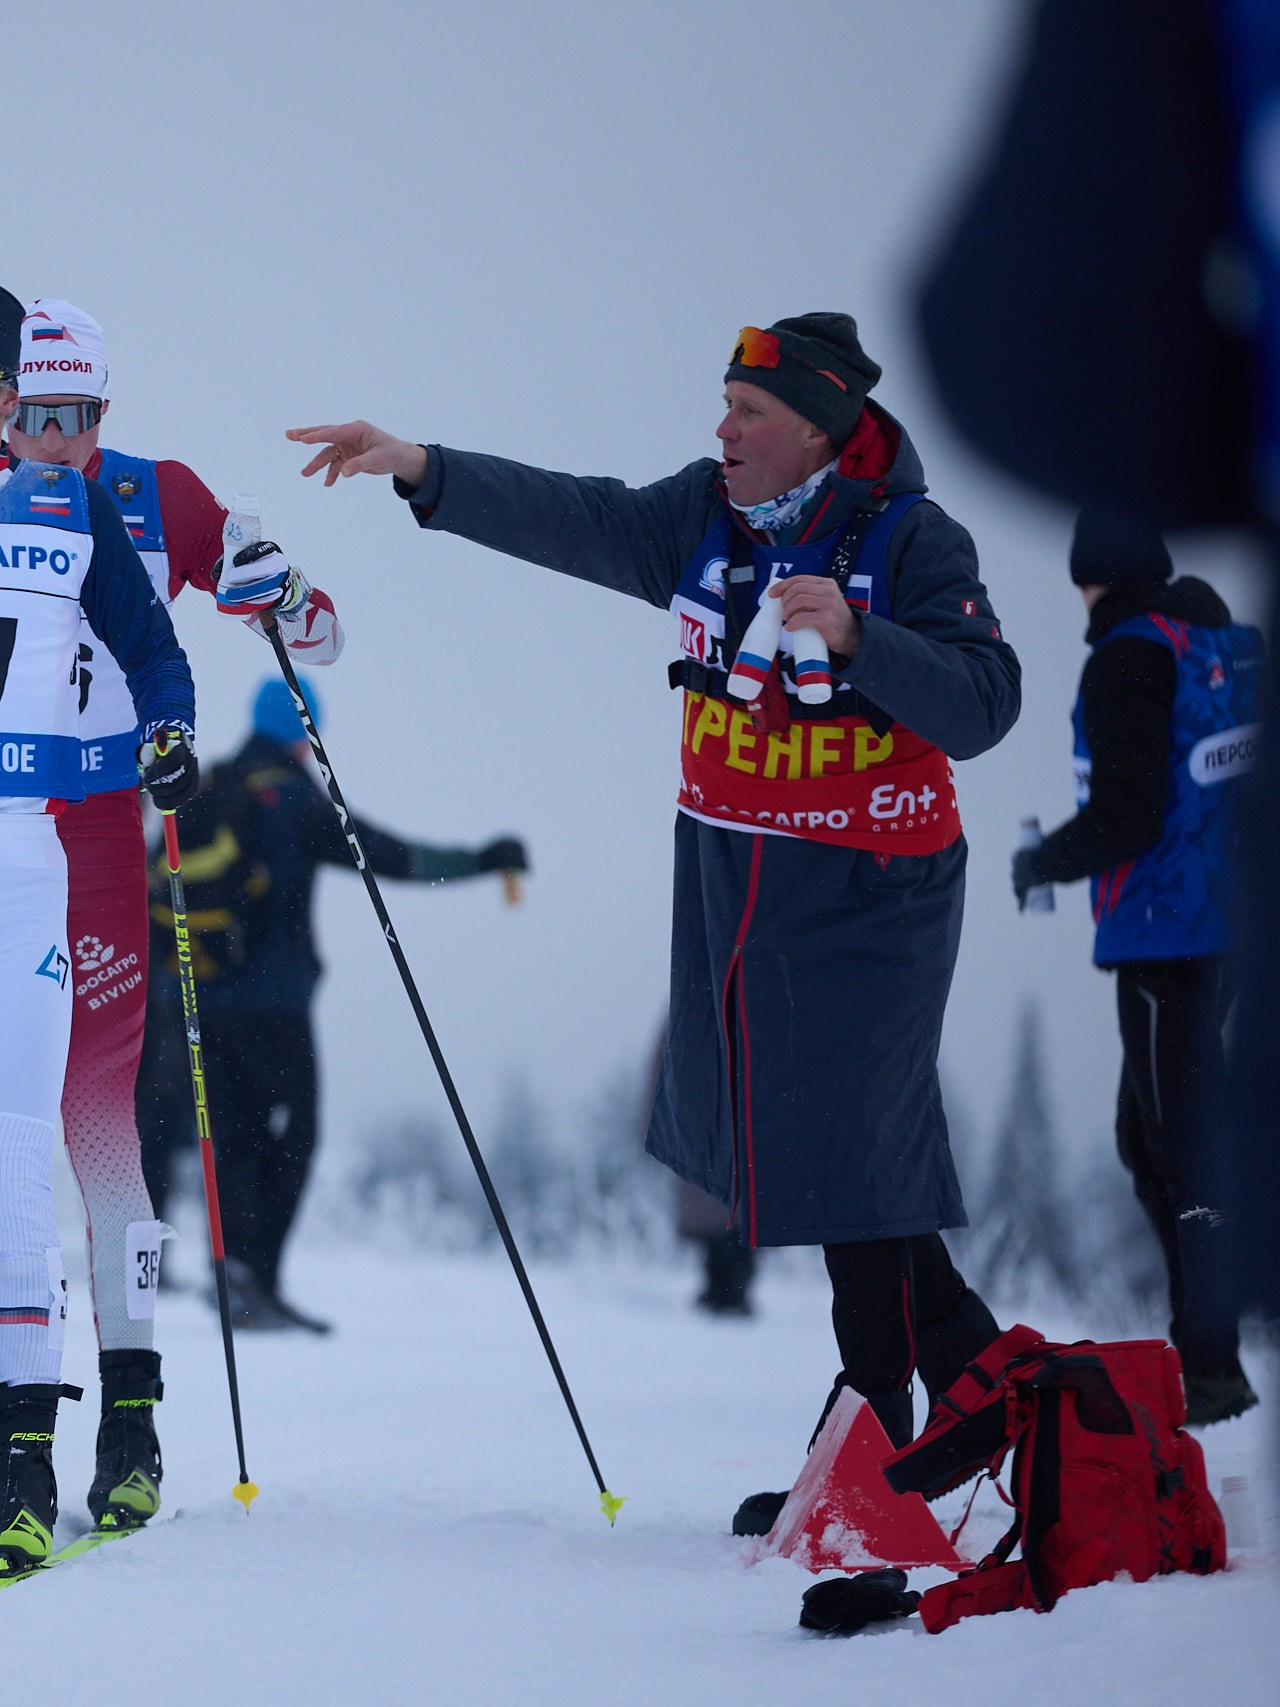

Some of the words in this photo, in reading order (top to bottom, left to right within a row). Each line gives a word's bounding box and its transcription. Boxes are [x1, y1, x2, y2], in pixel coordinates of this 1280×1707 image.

[22, 359, 92, 374] ЛУКОЙЛ
[872, 812, 939, 832] GROUP
[76, 953, 138, 996] ФОСАГРО
[87, 971, 143, 1010] BIVIUM
[137, 1250, 157, 1289] 36
